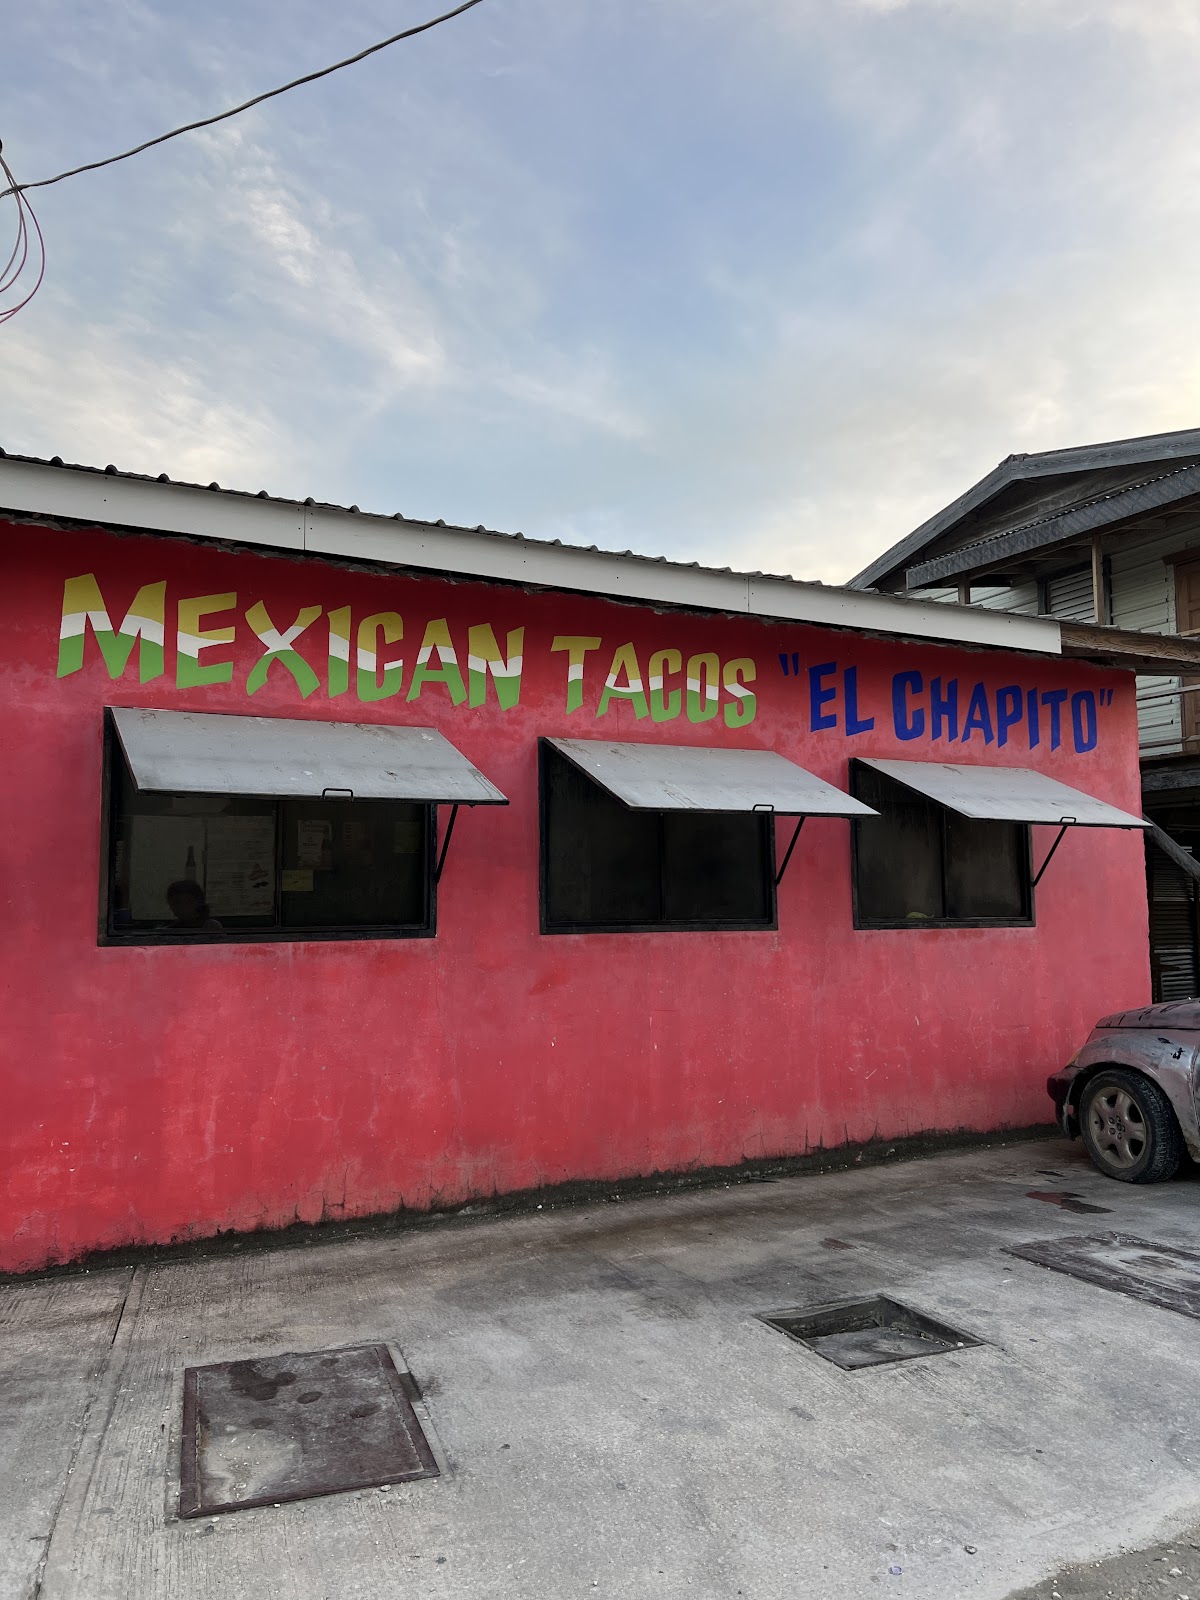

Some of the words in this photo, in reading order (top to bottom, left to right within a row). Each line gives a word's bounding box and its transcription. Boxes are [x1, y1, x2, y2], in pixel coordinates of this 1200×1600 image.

[57, 573, 524, 711] MEXICAN
[551, 635, 757, 729] TACOS
[779, 652, 874, 736] "EL
[892, 670, 1114, 753] CHAPITO"
